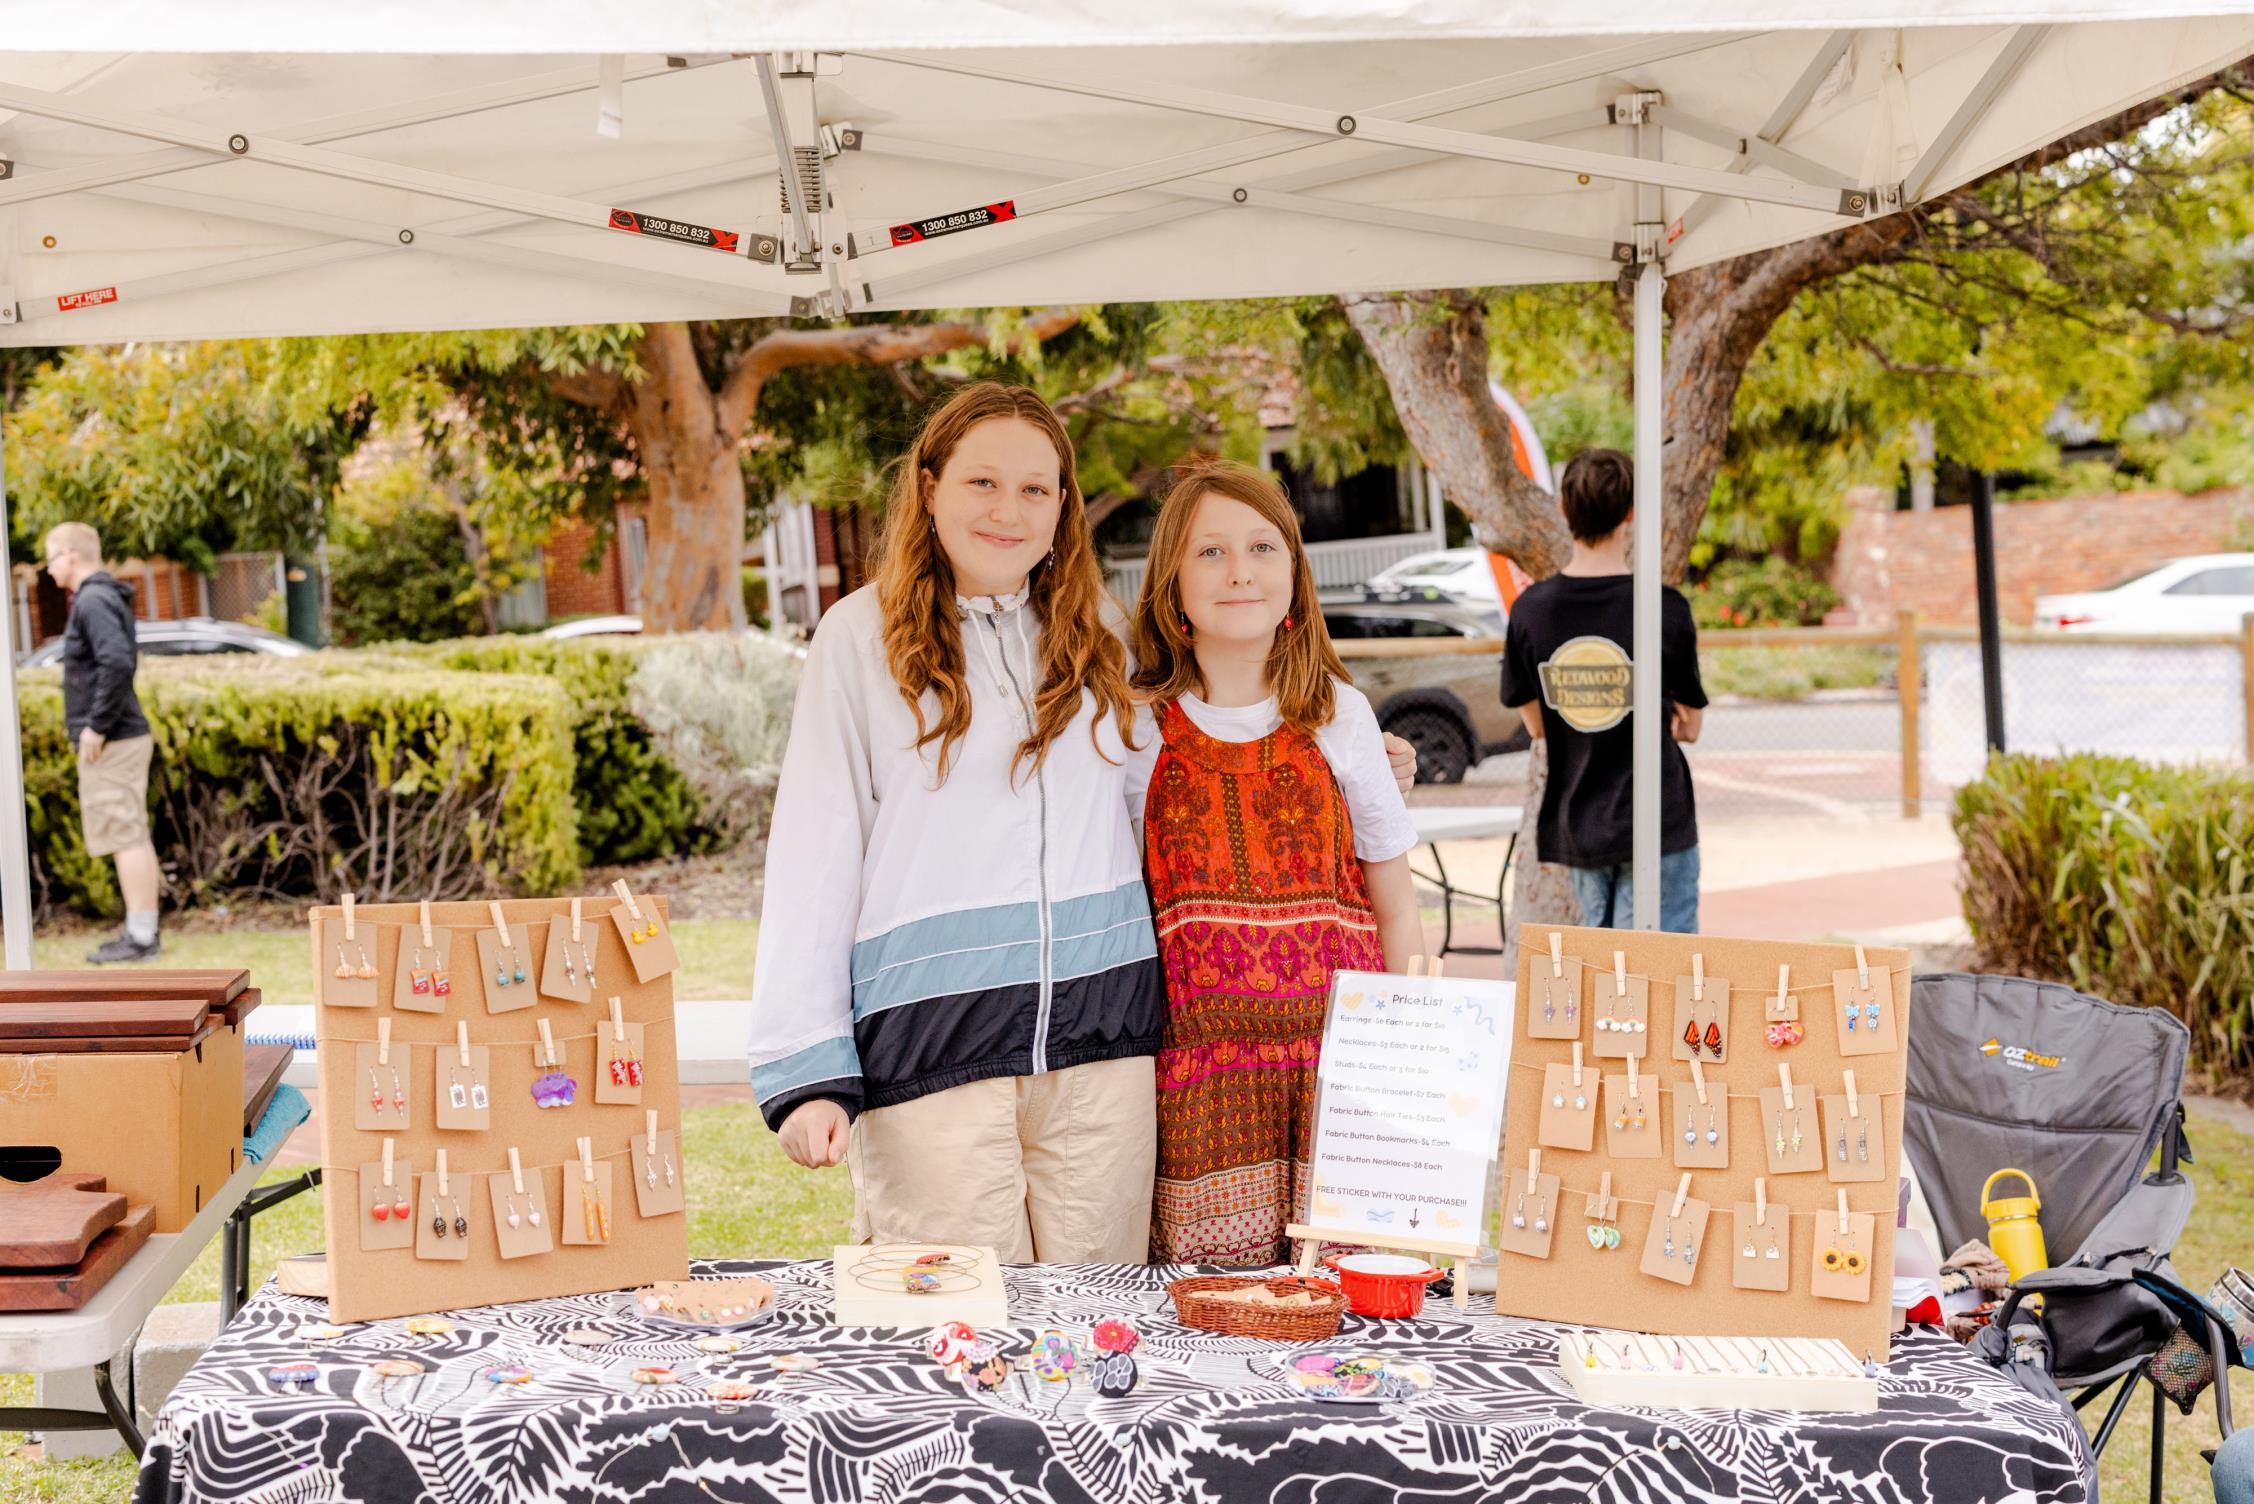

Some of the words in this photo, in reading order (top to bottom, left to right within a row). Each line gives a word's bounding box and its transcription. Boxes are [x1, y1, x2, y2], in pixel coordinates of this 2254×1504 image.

[643, 218, 667, 231] 1300
[670, 223, 688, 235] 850
[691, 226, 710, 239] 832
[922, 220, 946, 232] 1300
[948, 215, 966, 226] 850
[969, 210, 988, 221] 832
[61, 294, 82, 306] LIFT
[85, 289, 113, 302] HERE
[1392, 994, 1420, 1005] Price
[1423, 996, 1444, 1006] List
[1369, 1063, 1387, 1071] Each
[1330, 1083, 1353, 1092] Fabric
[1355, 1086, 1380, 1094] Button
[1426, 1091, 1445, 1099] Each
[1329, 1106, 1352, 1115] Fabric
[1354, 1108, 1378, 1118] Button
[1380, 1111, 1396, 1119] Hair
[1426, 1115, 1446, 1123] Each
[1325, 1130, 1348, 1139] Fabric
[1350, 1132, 1374, 1140] Button
[1431, 1138, 1450, 1146] Each
[1321, 1153, 1344, 1162] Fabric
[1346, 1156, 1370, 1164] Button
[1424, 1162, 1443, 1171] Each
[1316, 1186, 1336, 1194] FREE
[1337, 1188, 1370, 1198] STICKER
[1371, 1191, 1392, 1200] WITH
[1394, 1193, 1417, 1202] YOUR
[1418, 1195, 1467, 1208] PURCHASE!!!
